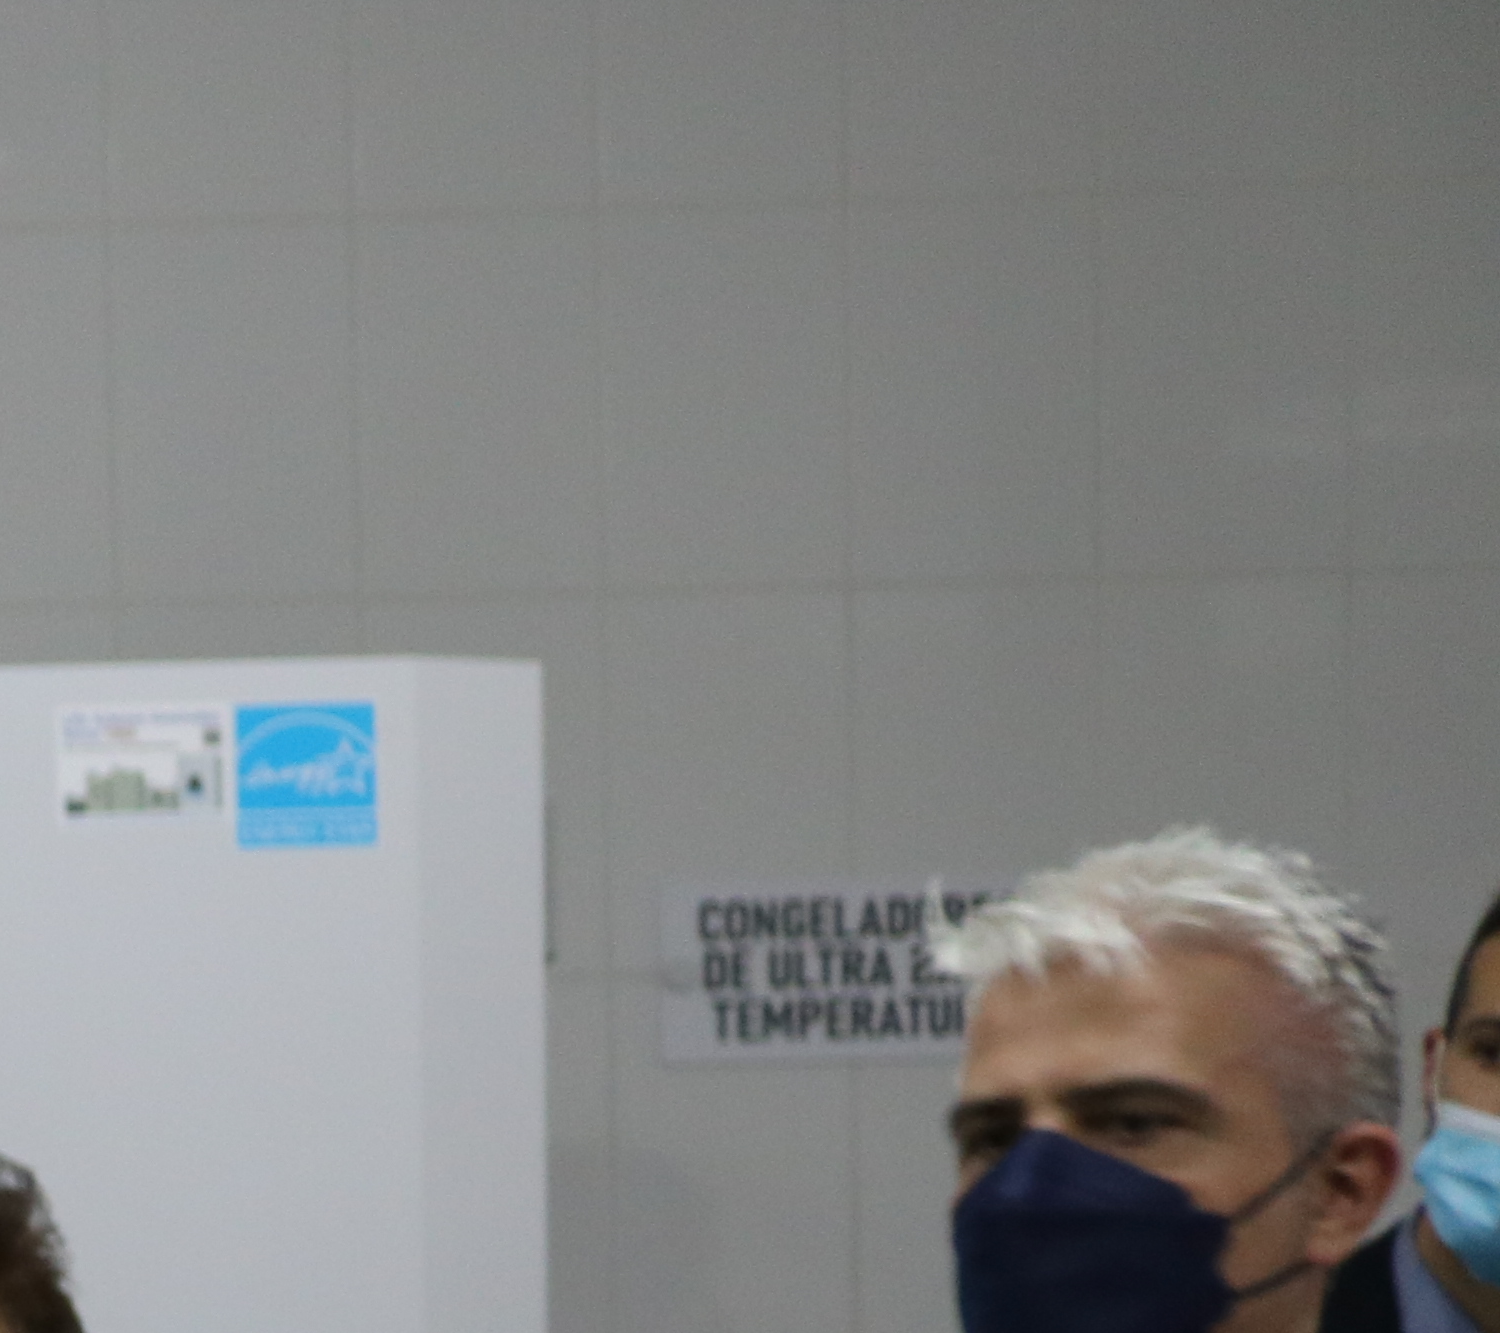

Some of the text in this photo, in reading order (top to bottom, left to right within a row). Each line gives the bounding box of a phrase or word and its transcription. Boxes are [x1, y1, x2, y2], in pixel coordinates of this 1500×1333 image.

[704, 950, 741, 988] DE
[769, 948, 892, 987] ULTRA
[716, 996, 964, 1041] TEMPERATU
